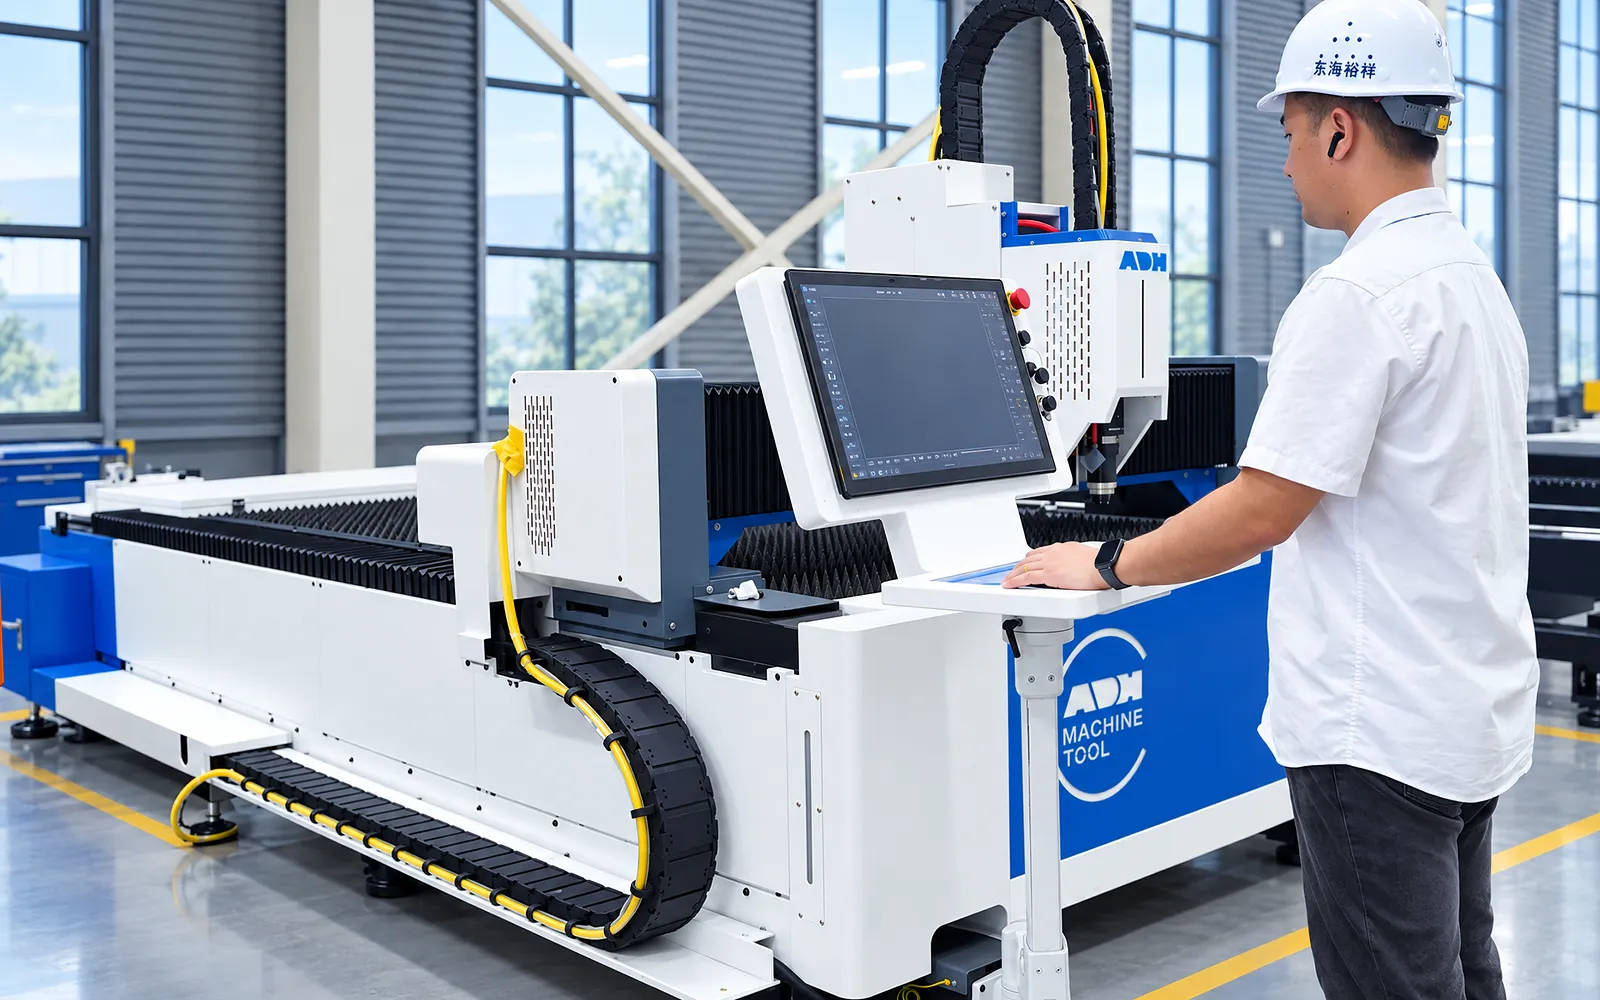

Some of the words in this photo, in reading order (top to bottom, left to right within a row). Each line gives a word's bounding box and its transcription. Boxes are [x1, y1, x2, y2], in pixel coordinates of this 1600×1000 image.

[1314, 60, 1377, 79] 东海裕祥
[1119, 251, 1167, 272] ADH
[1063, 670, 1143, 718] ADH
[1062, 708, 1143, 745] MACHINE
[1062, 740, 1110, 767] TOOL
